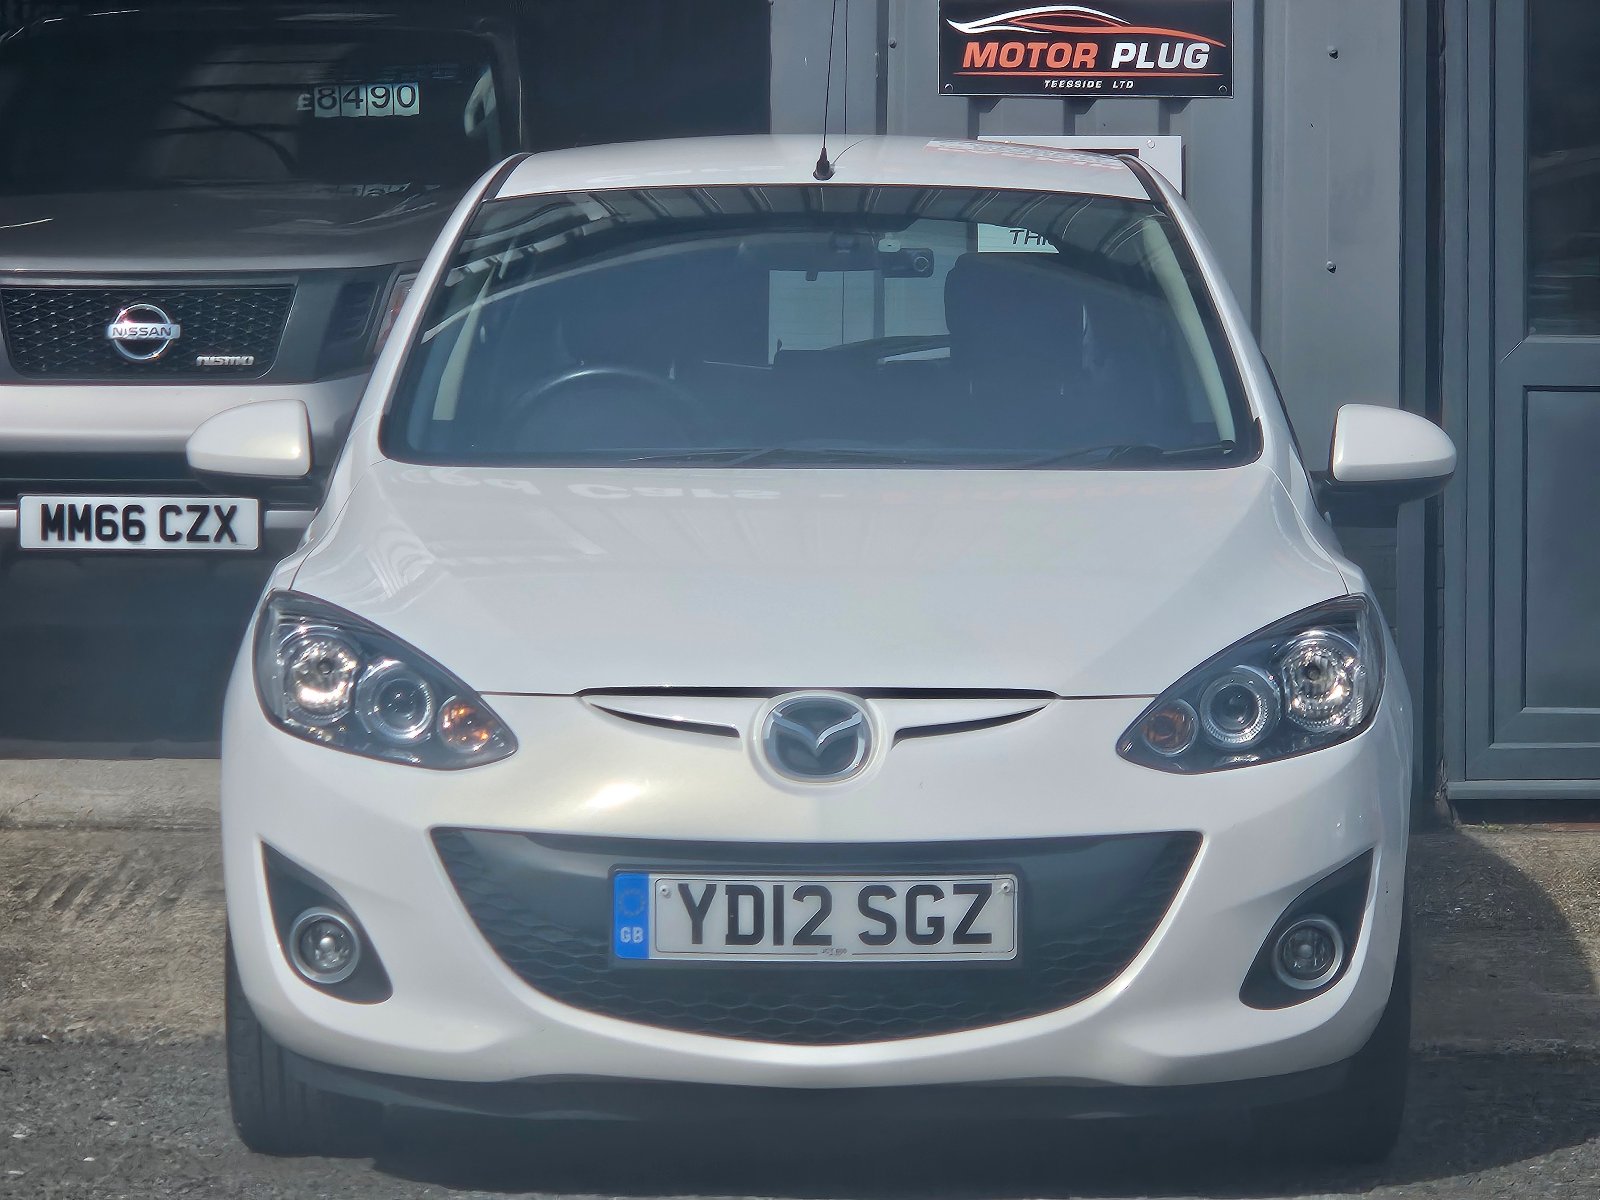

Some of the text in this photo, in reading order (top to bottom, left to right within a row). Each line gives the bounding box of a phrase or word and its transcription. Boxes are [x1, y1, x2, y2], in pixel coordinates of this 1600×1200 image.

[962, 42, 1210, 69] MOTOR PLUG
[1044, 79, 1134, 90] TEESSIDE LTD
[112, 326, 172, 337] NISSAN
[41, 503, 238, 543] MM66 CZX
[677, 883, 993, 946] YD12 SGZ
[620, 926, 644, 944] GB
